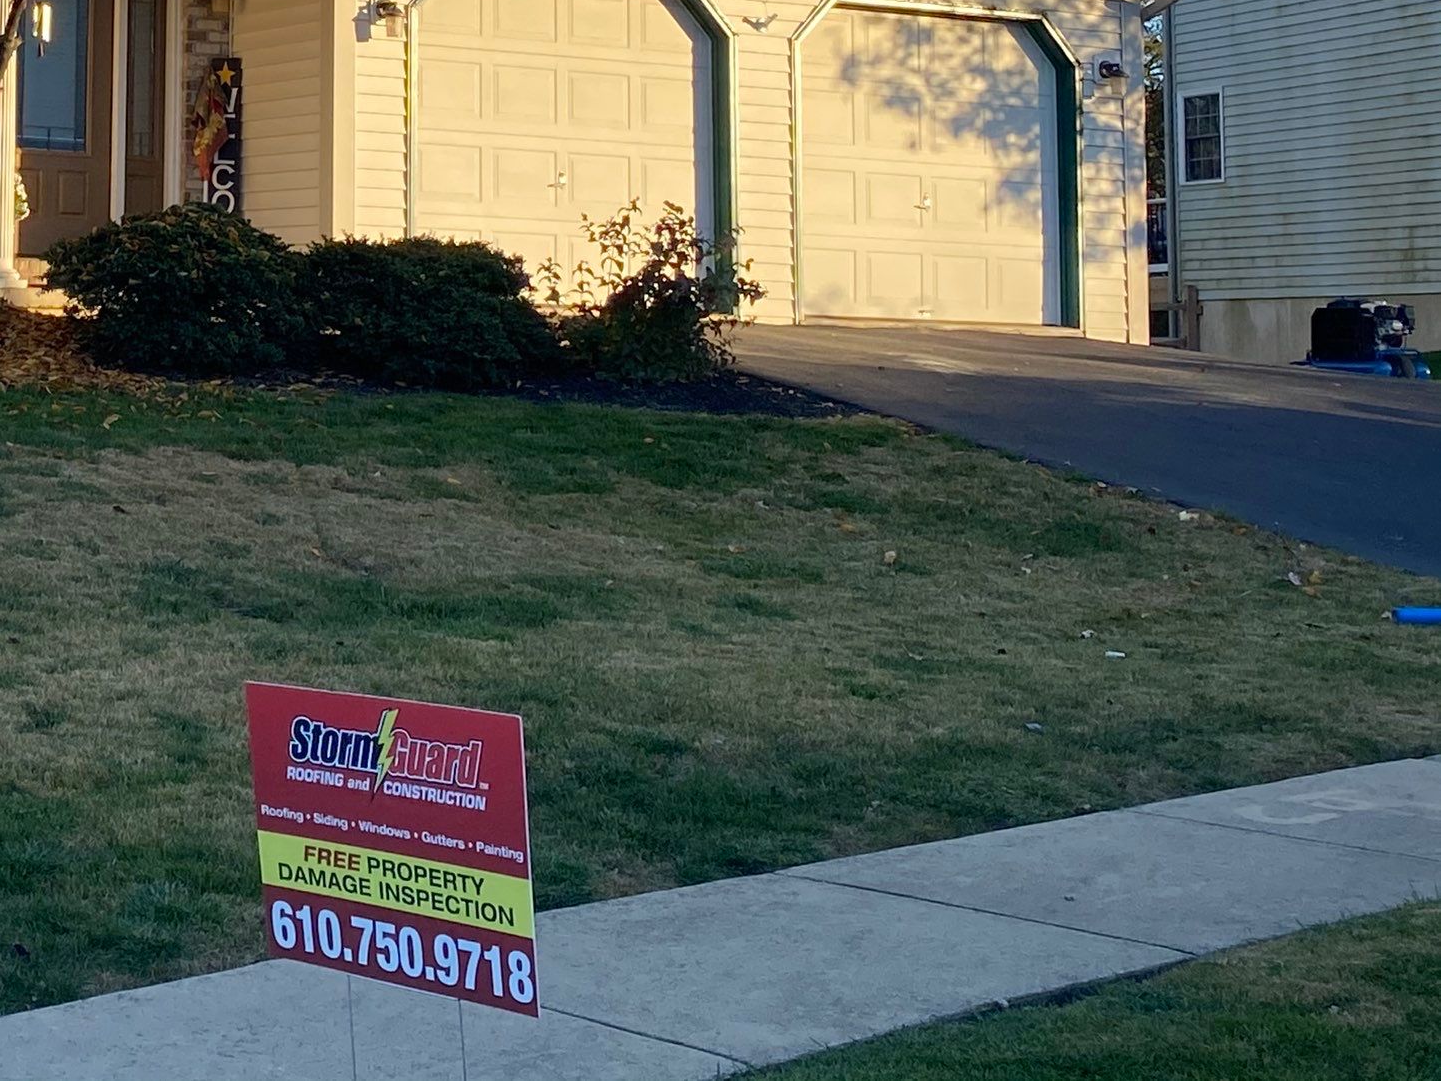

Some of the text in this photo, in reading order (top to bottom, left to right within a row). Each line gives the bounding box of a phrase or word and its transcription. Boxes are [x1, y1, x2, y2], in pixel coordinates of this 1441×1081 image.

[290, 716, 481, 788] Storm Guard
[287, 766, 486, 811] ROOFING and CONSTRUCTION
[261, 805, 524, 863] Roofing Siding Windows Gutters Painting
[278, 862, 514, 927] DAMAGE INSPECTION
[304, 845, 484, 896] FREE PROPERTY
[271, 900, 534, 1004] 610.750.9718
